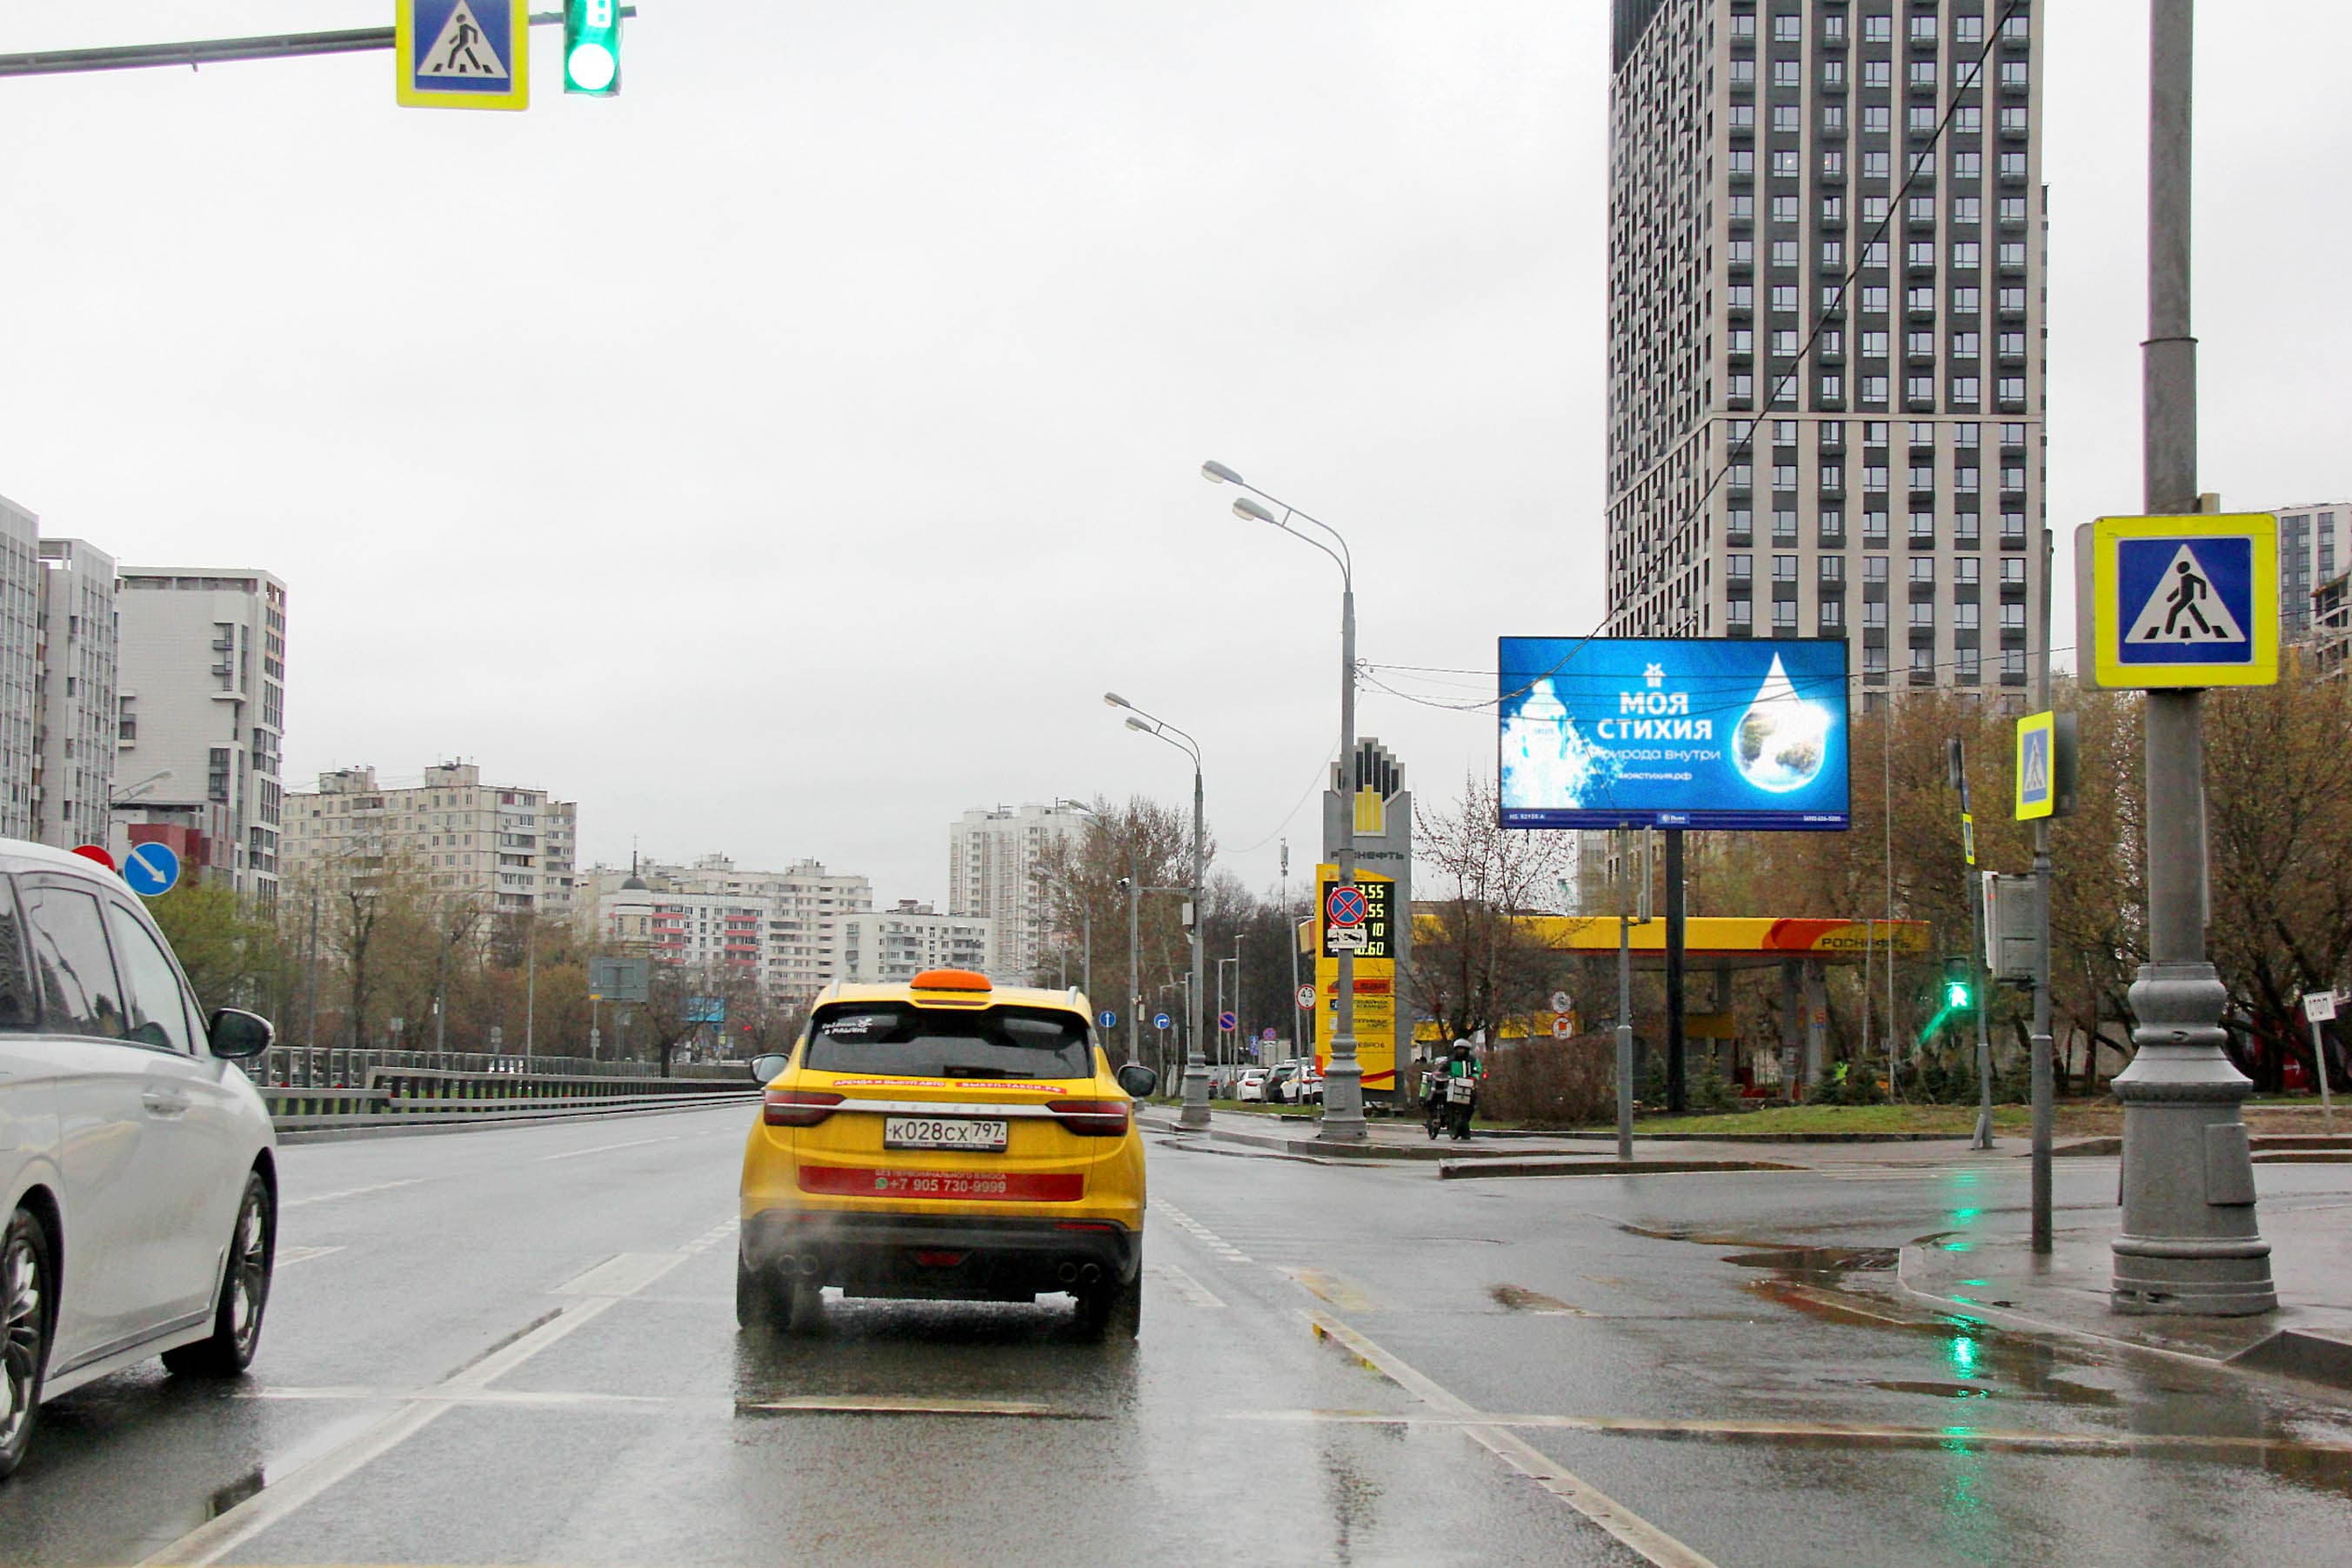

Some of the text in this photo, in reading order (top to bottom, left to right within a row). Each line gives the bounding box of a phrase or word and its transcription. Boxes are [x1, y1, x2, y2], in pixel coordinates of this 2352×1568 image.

[1620, 691, 1688, 715] МОЯ
[1597, 719, 1713, 740] СТИХИЯ
[1665, 749, 1721, 762] внутри
[1331, 851, 1405, 860] РНЕФТЬ
[974, 1122, 1002, 1138] 797
[891, 1178, 1007, 1193] +7 905 730-9999
